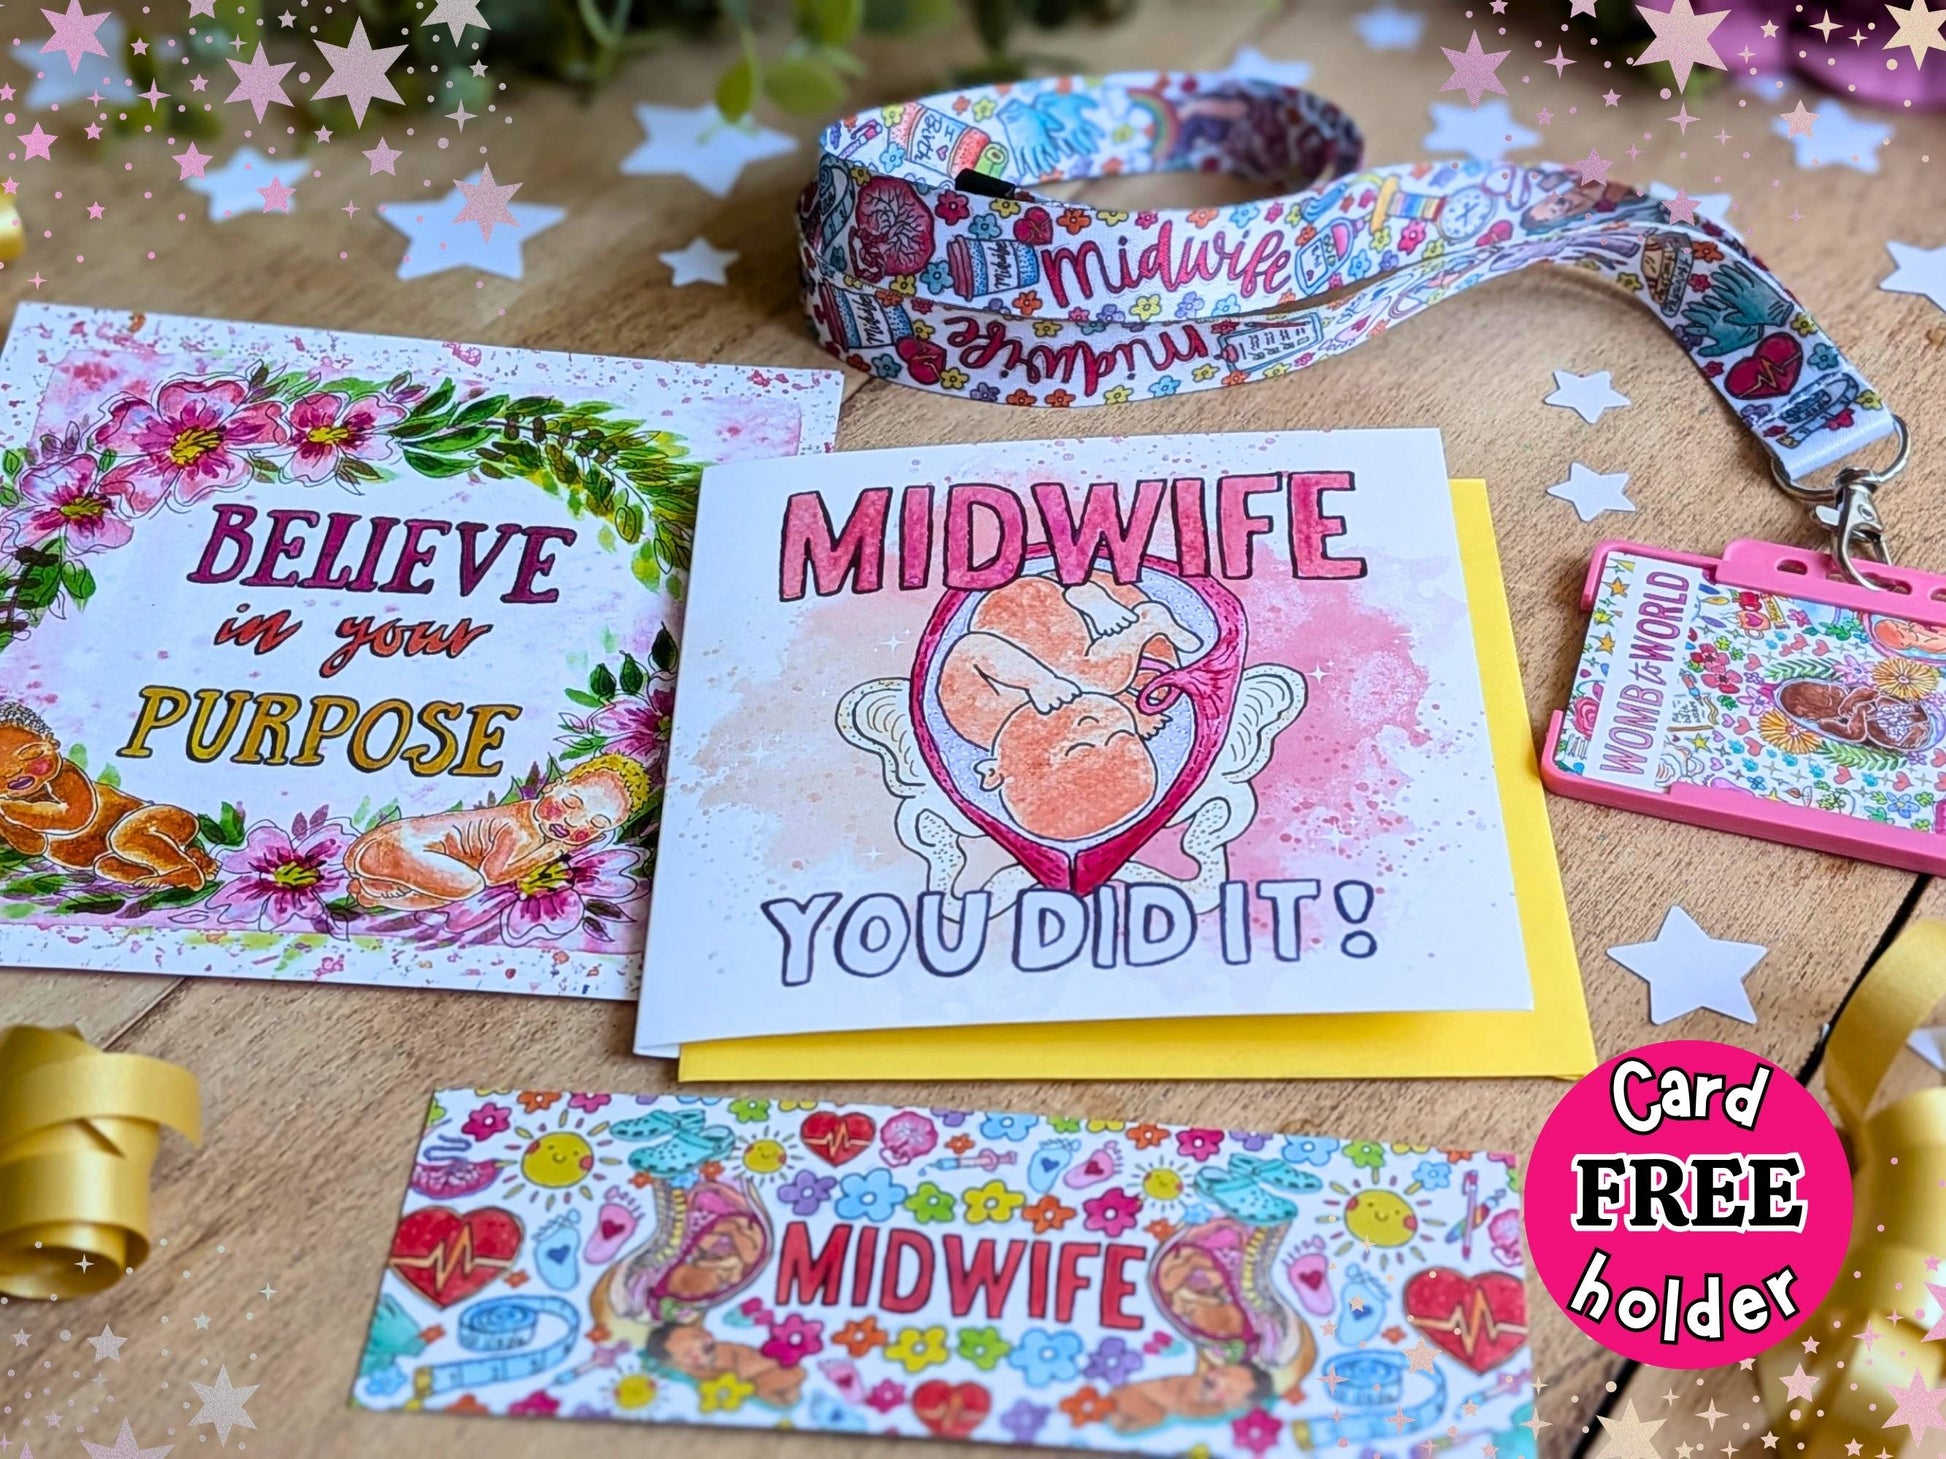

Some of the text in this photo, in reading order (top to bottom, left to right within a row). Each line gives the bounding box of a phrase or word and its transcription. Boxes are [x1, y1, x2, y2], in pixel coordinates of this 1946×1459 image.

[914, 113, 942, 160] Birth
[187, 503, 577, 604] BELIEVE
[778, 470, 1368, 602] MIDWIFE
[214, 603, 493, 678] in your
[1630, 571, 1690, 662] WORLD
[1628, 660, 1667, 686] to
[116, 684, 523, 778] PURPOSE
[1600, 683, 1665, 775] WOMB
[760, 878, 1379, 986] YOU DID IT!
[774, 1220, 1146, 1331] MIDWIFE
